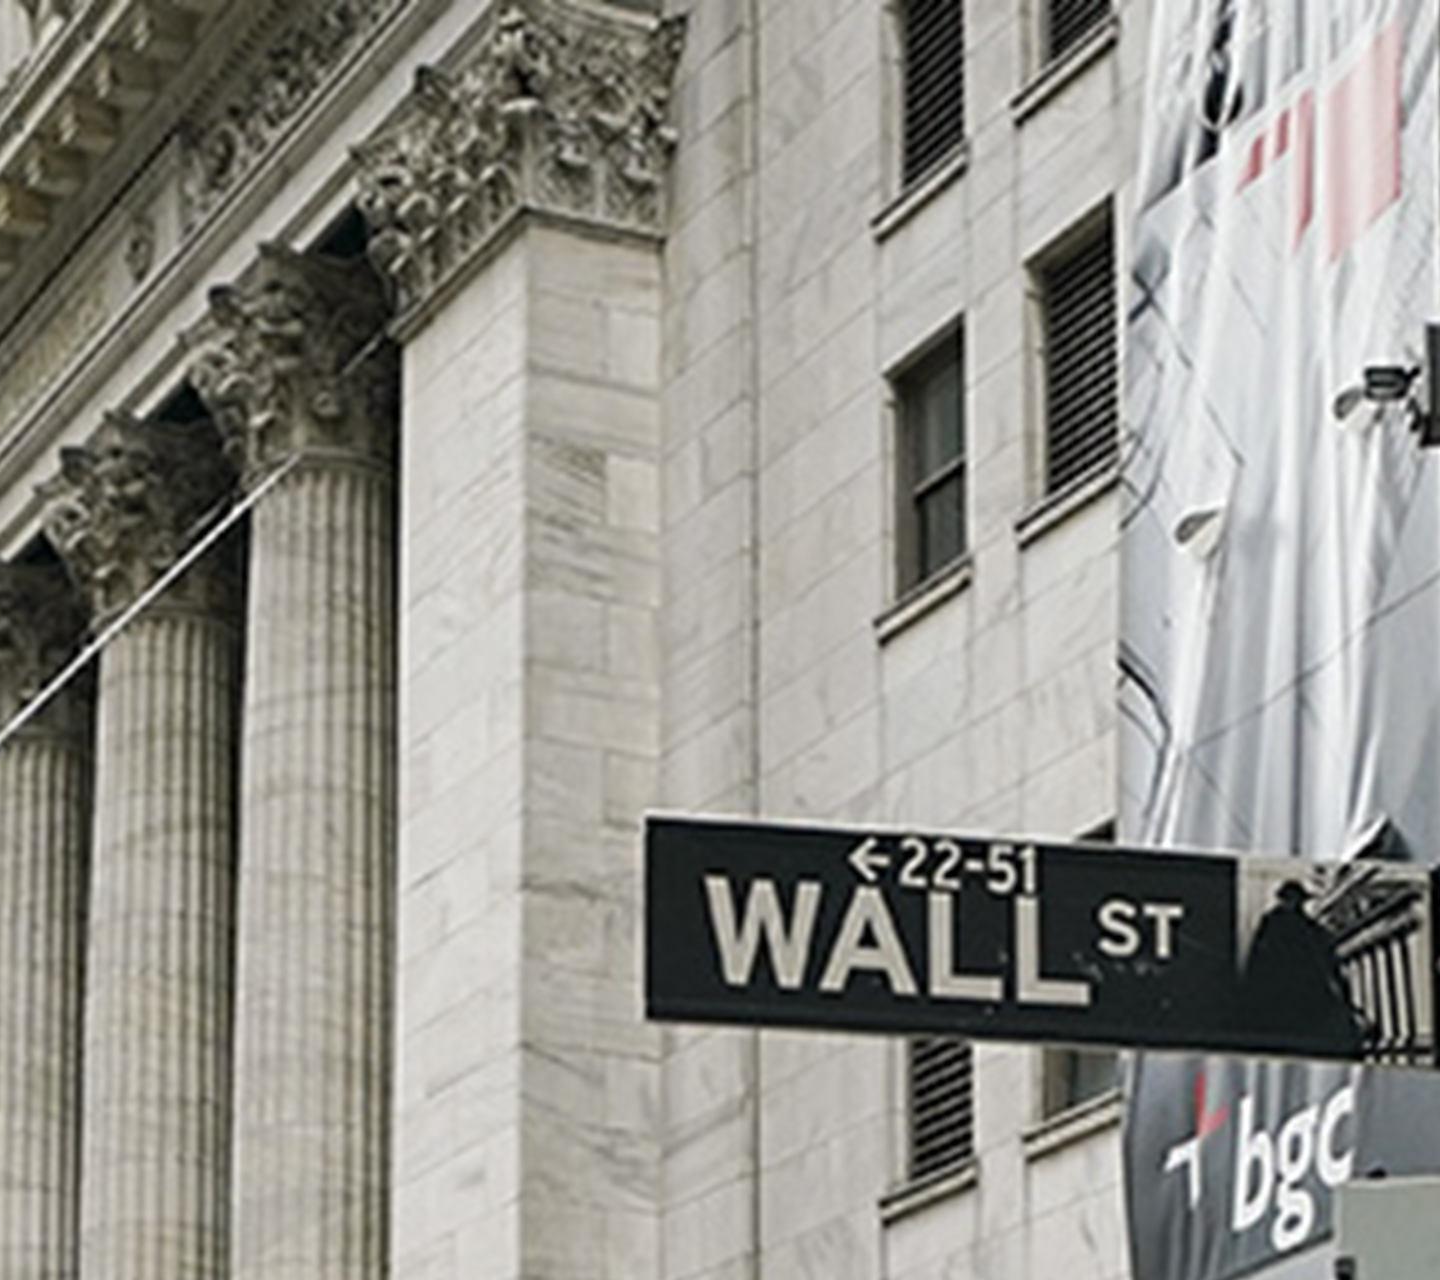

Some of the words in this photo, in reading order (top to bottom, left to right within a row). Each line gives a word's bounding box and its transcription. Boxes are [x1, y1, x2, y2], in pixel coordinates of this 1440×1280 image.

[899, 838, 1038, 895] 22-51
[703, 875, 1091, 1006] WALL
[1097, 900, 1186, 960] ST
[1232, 1084, 1356, 1250] bgc
